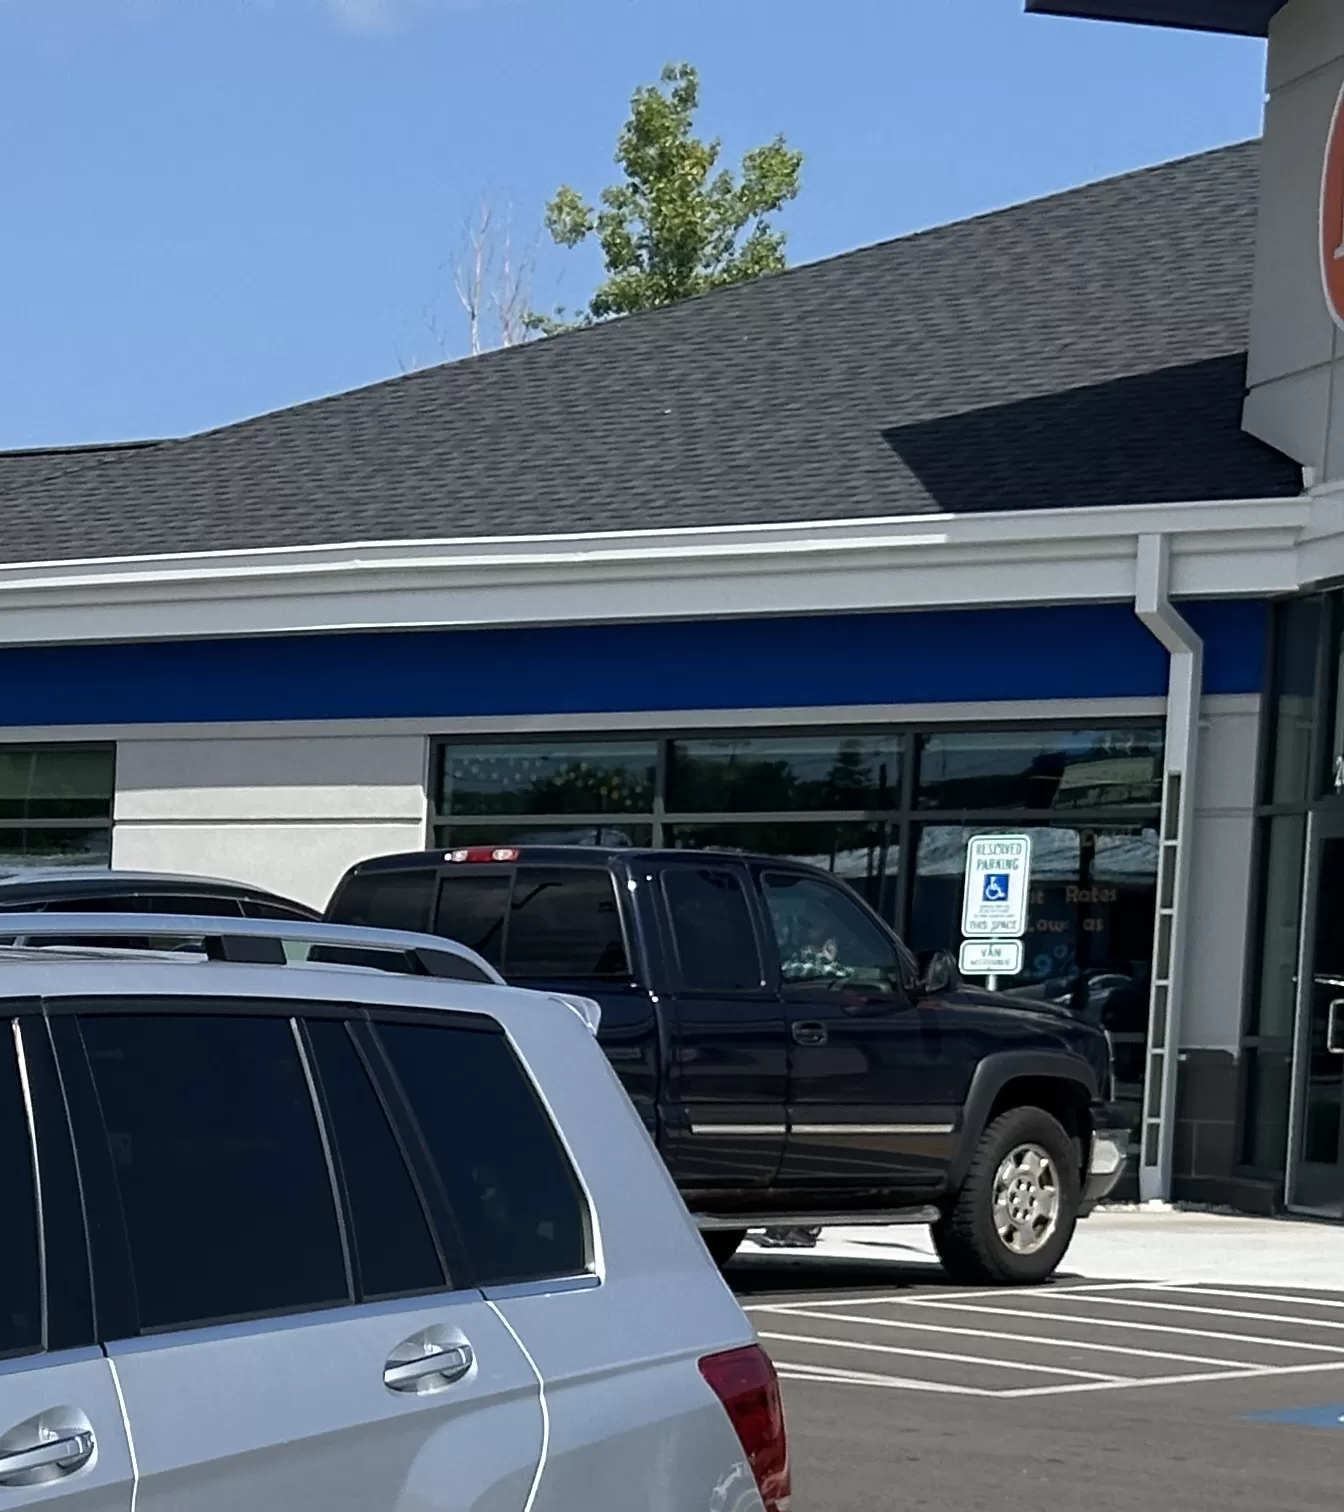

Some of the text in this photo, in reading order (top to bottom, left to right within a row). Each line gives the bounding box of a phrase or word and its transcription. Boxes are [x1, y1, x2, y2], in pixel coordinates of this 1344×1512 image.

[976, 843, 1022, 855] RESERVED
[976, 858, 1020, 871] PARKING
[969, 920, 1017, 930] THIS SPACE
[981, 948, 1002, 957] VAN
